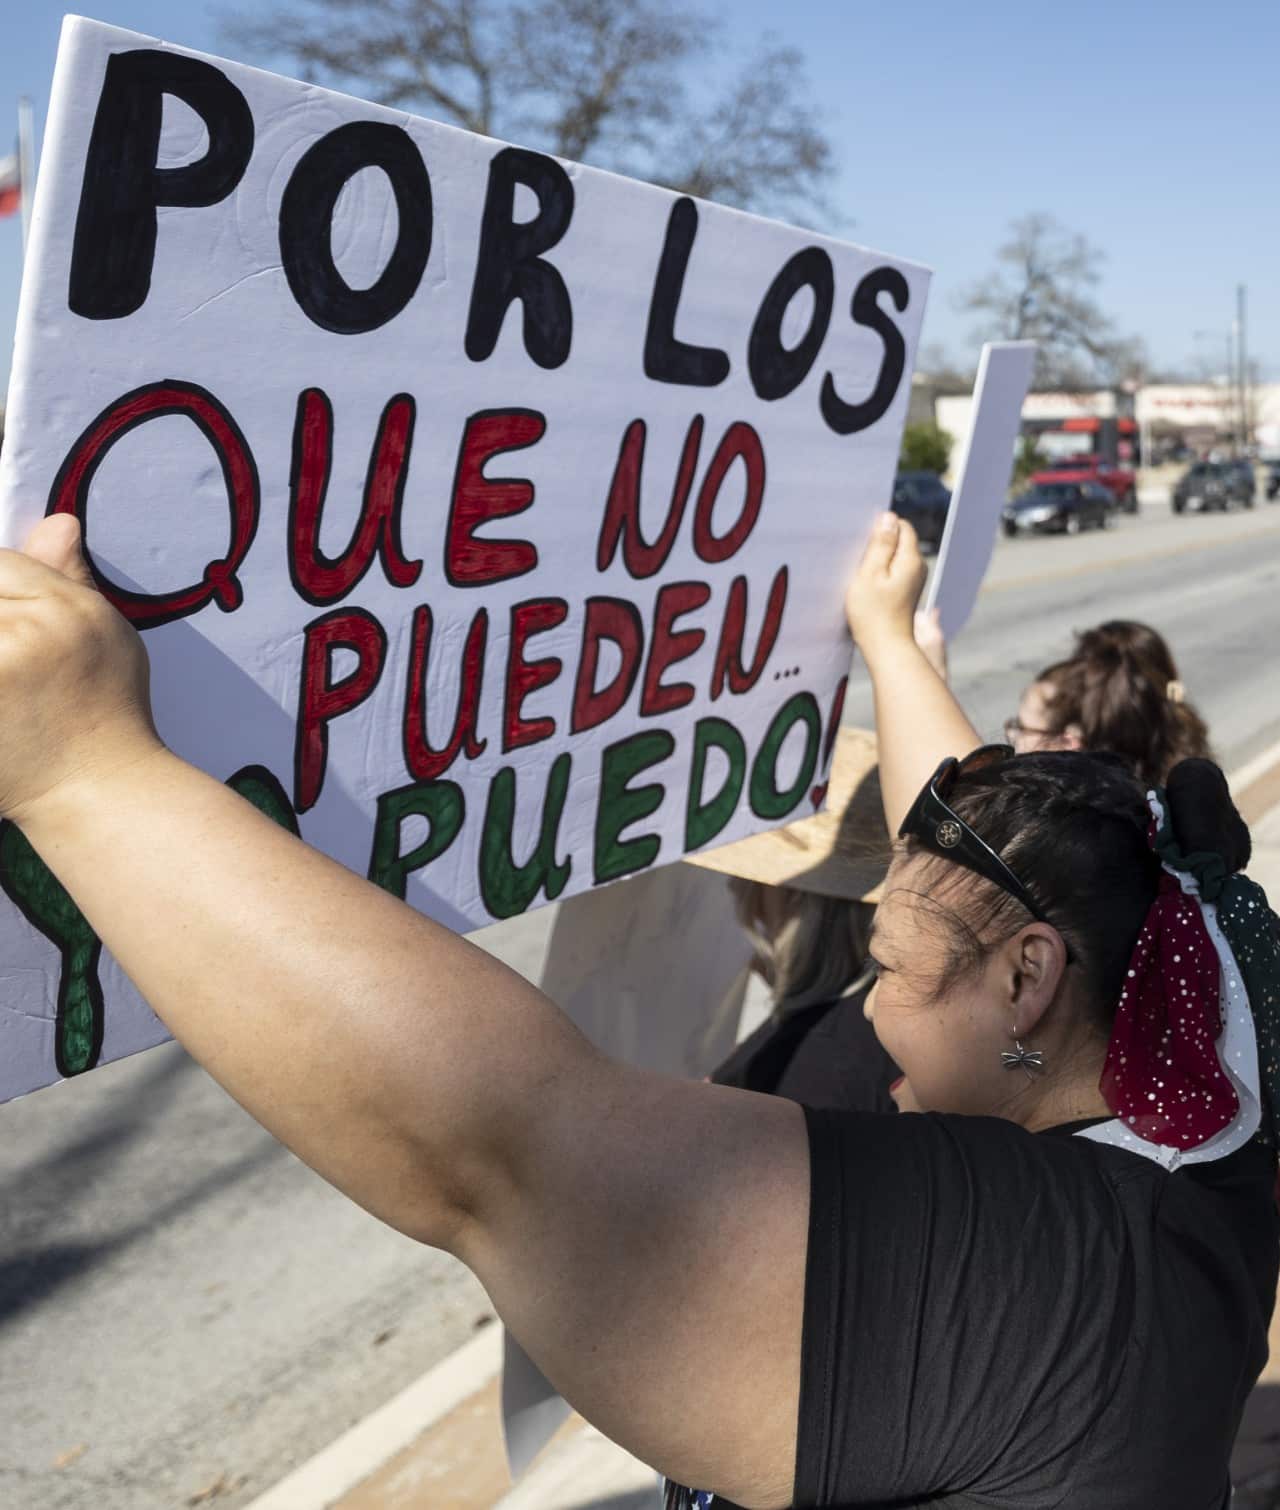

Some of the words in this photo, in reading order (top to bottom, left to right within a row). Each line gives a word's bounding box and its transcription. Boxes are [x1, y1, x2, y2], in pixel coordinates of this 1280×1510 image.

[68, 49, 575, 370] POR
[644, 197, 910, 435] LOS
[47, 379, 547, 630] QUE
[597, 413, 767, 580] NO
[369, 673, 849, 920] PUEDO!
